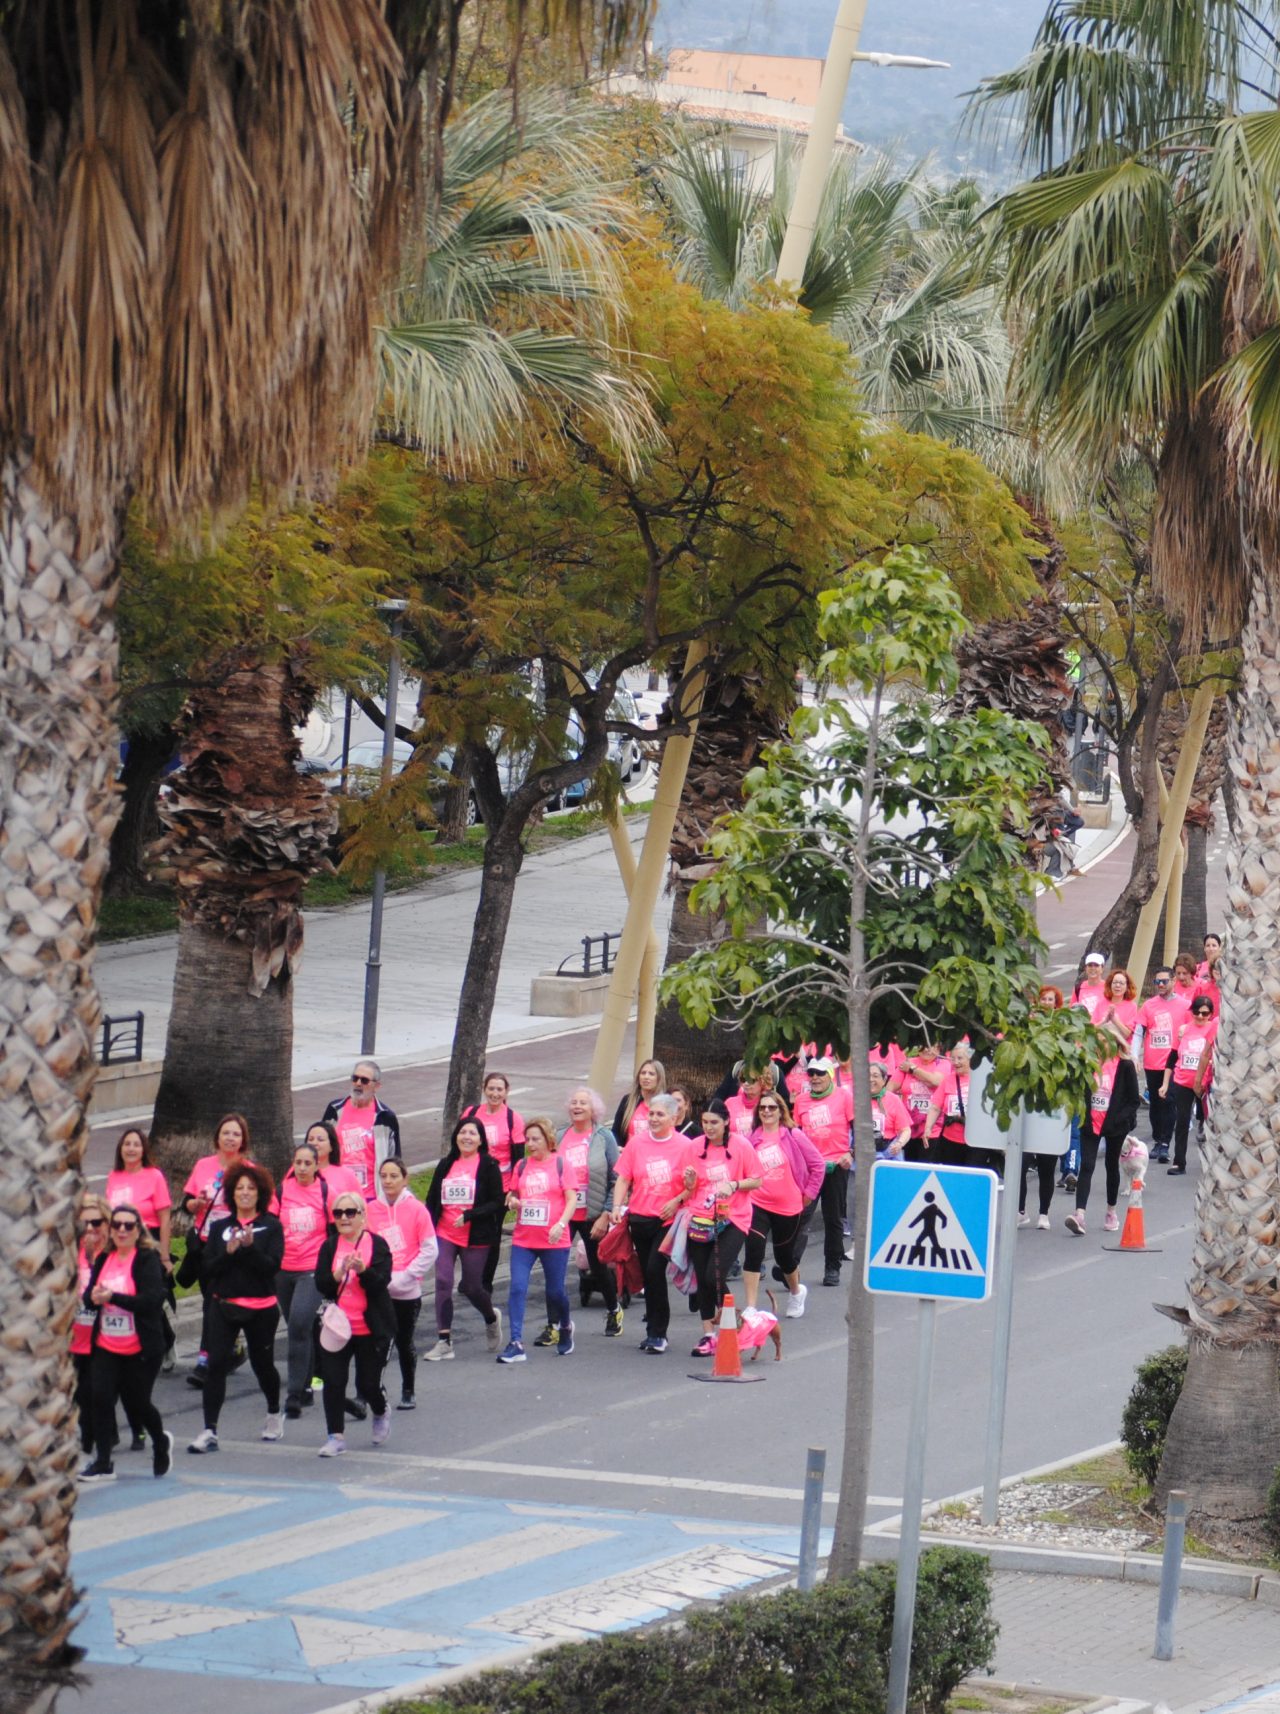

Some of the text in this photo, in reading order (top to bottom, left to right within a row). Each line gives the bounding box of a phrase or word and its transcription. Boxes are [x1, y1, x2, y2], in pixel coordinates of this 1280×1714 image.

[1185, 1056, 1199, 1064] 207
[914, 1100, 929, 1108] 273
[449, 1188, 466, 1197] 555
[524, 1208, 540, 1217] 561
[106, 1317, 123, 1328] 547
